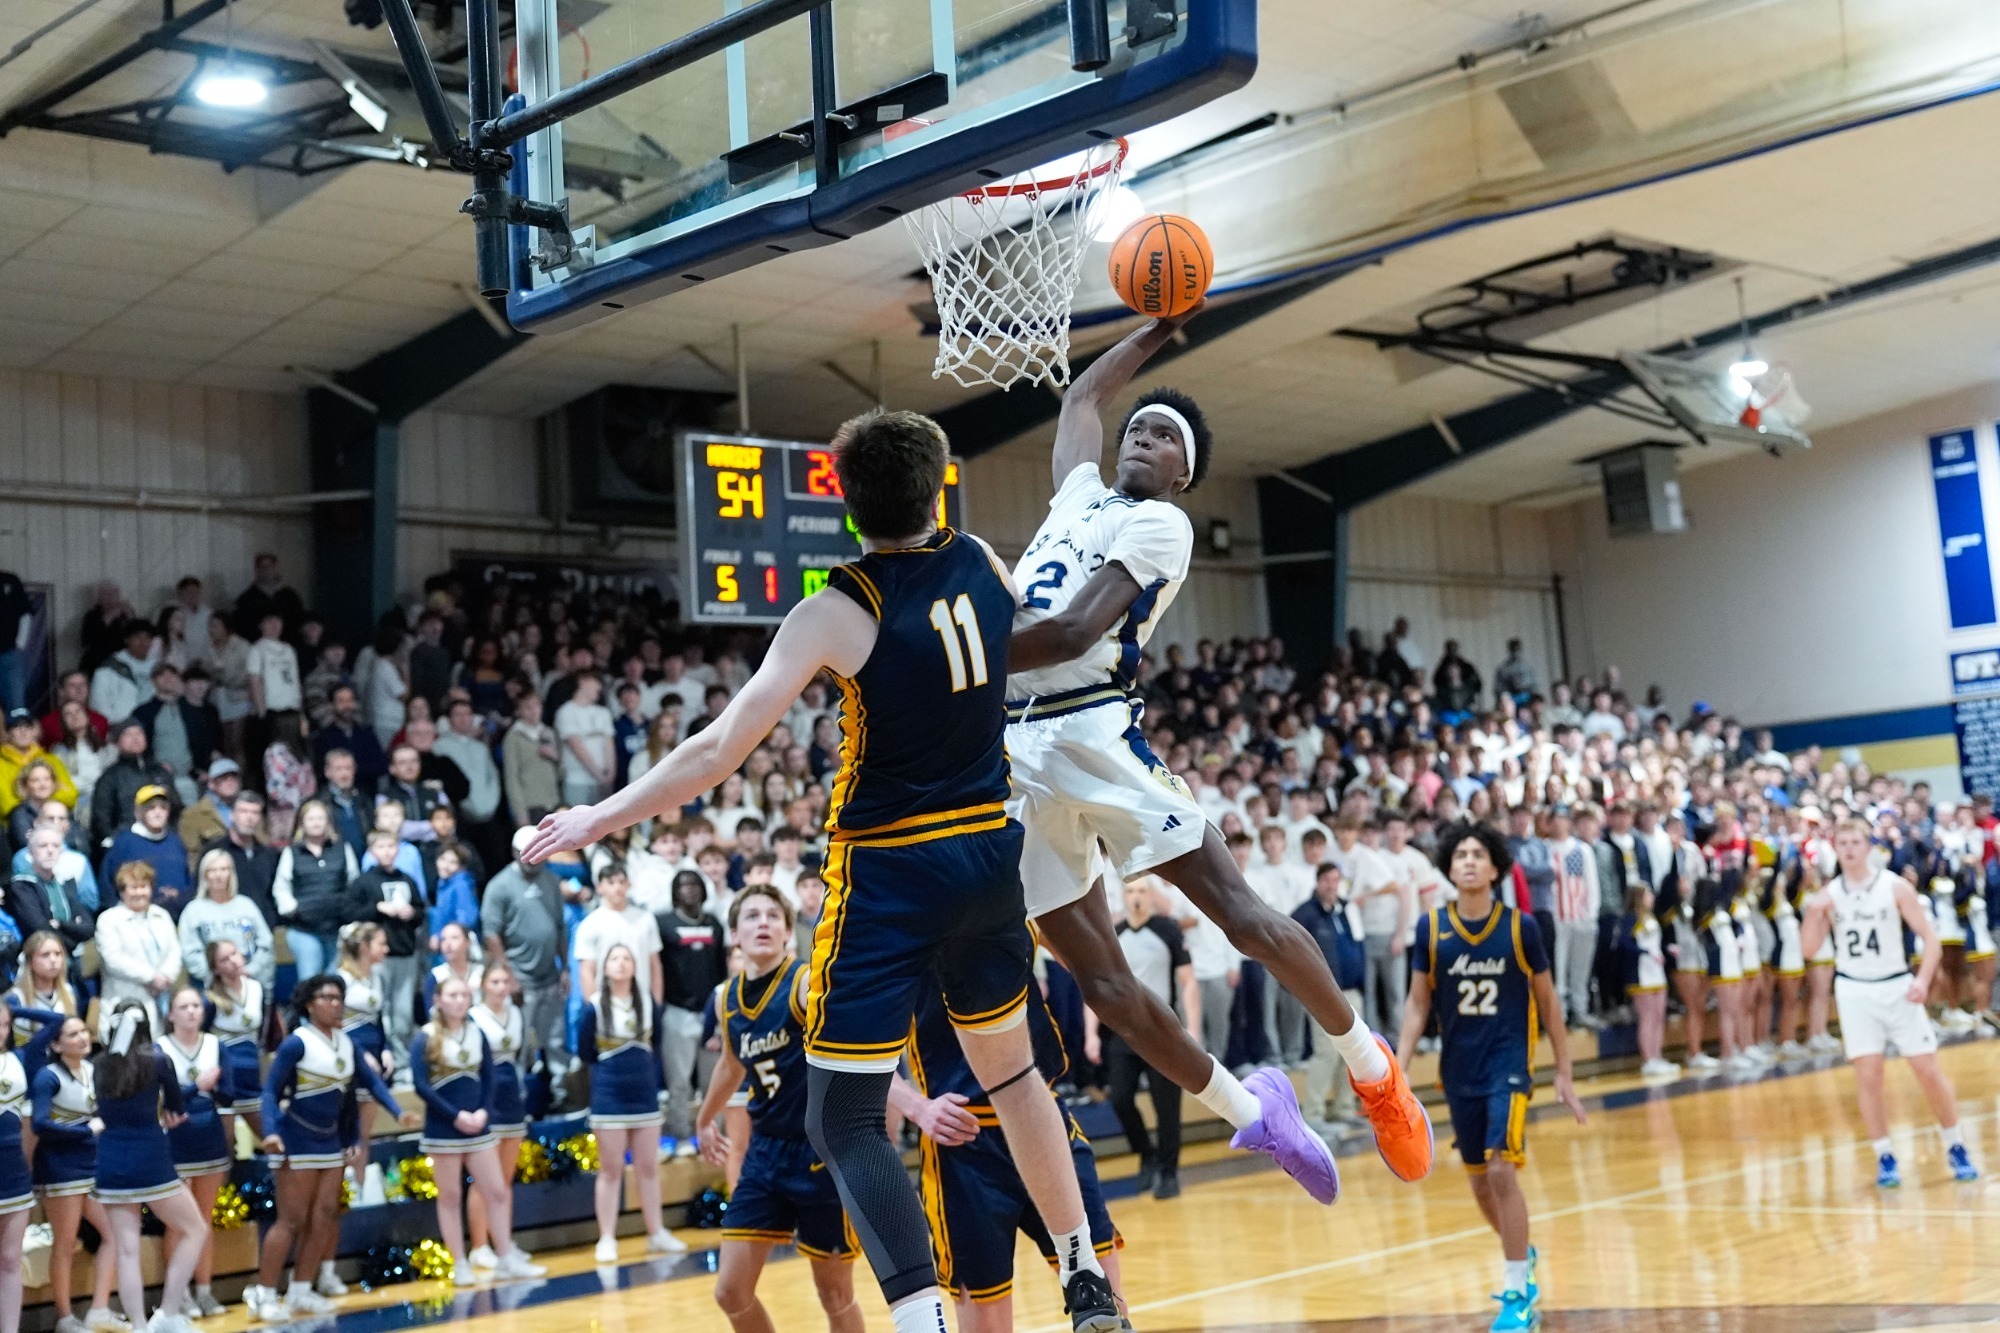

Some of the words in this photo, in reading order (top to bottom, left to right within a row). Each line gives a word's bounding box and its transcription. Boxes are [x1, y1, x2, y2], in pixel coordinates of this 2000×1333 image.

[1143, 251, 1163, 313] Wilson
[717, 471, 764, 519] 54
[716, 565, 739, 602] 5
[765, 567, 778, 603] 1
[929, 593, 988, 693] 11
[1846, 928, 1880, 958] 24
[1447, 953, 1506, 976] Marist
[1458, 979, 1499, 1016] 22
[754, 1058, 782, 1099] 5
